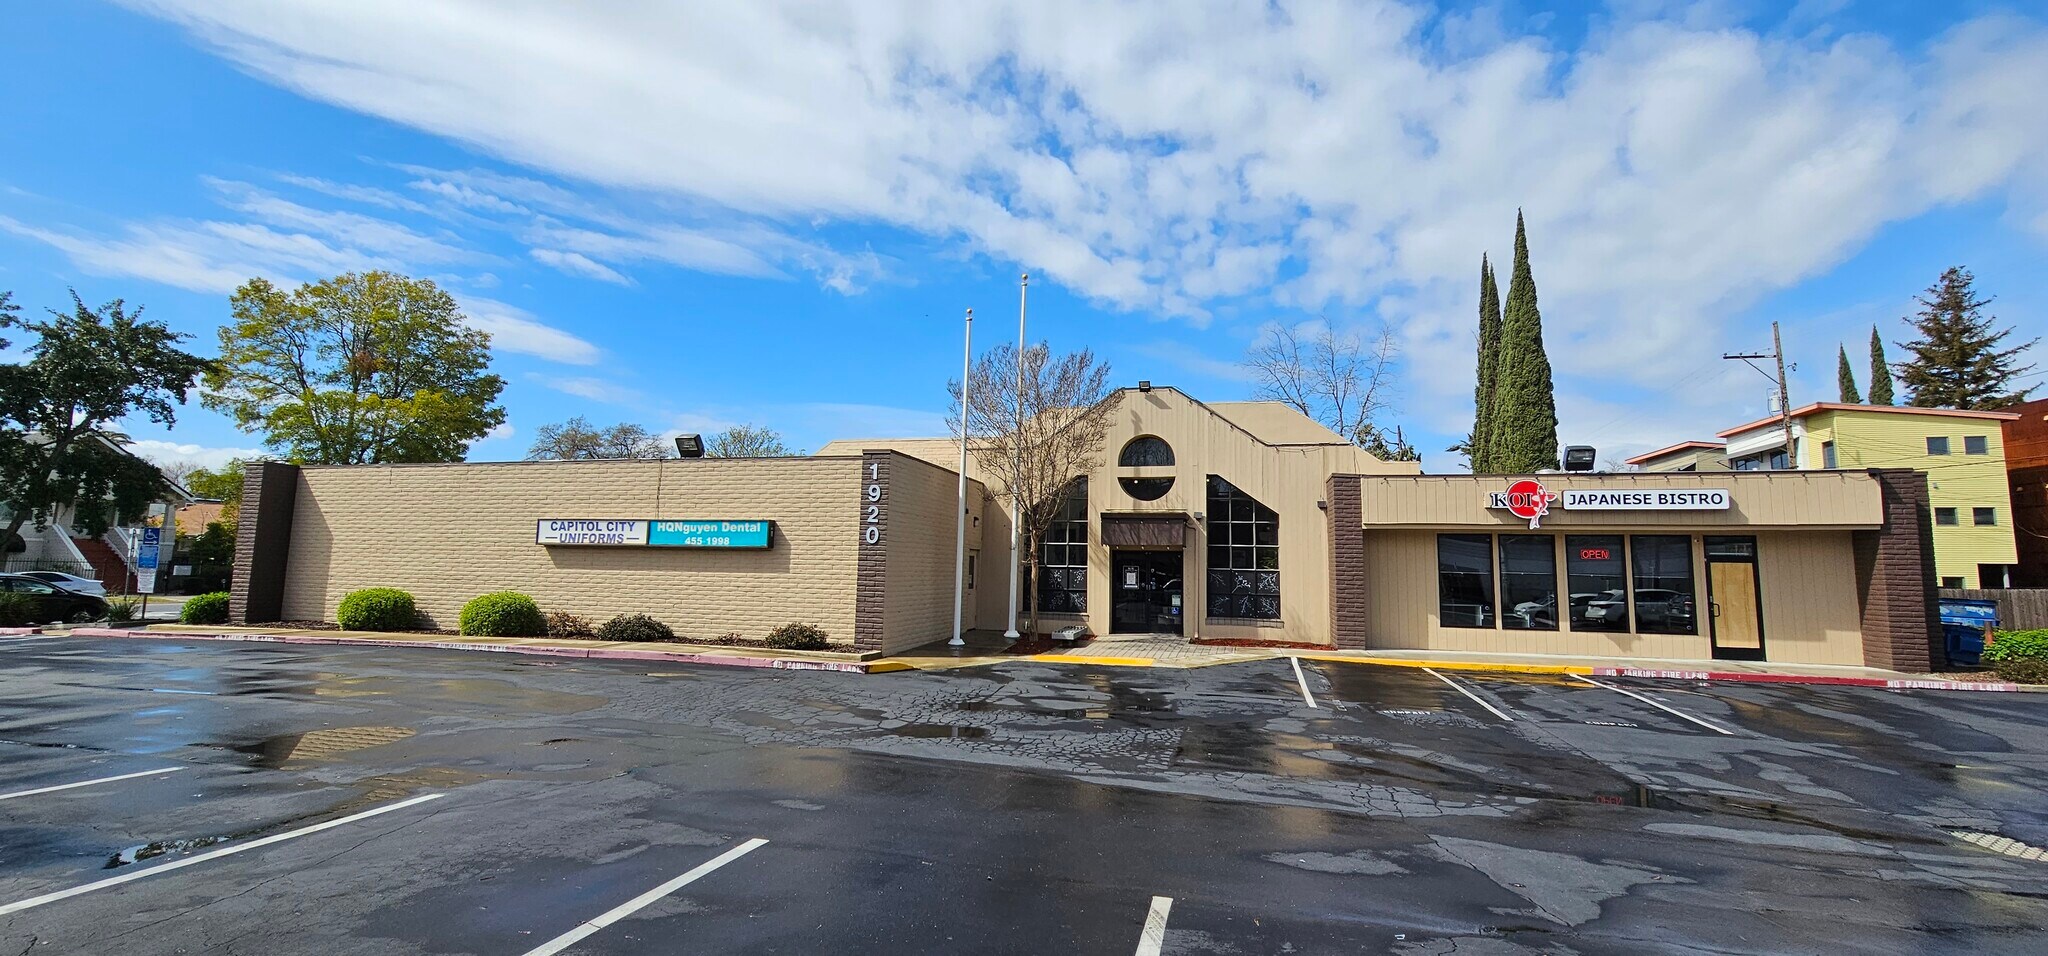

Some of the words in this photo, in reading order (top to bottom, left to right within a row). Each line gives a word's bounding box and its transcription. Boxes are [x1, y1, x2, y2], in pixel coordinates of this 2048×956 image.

[865, 463, 881, 544] 1920
[1491, 492, 1534, 508] KOI
[1568, 493, 1653, 506] JAPANESE
[1658, 492, 1724, 505] BISTRO
[550, 521, 602, 532] CAPITOL
[606, 521, 636, 532] CITY
[656, 521, 718, 534] HQNguyen
[721, 521, 761, 533] Dental
[559, 532, 624, 544] UNIFORMS
[1582, 550, 1608, 559] OPEN
[1606, 669, 1617, 677] NO
[1661, 670, 1681, 679] FIRE
[1887, 680, 1901, 688] NO
[1905, 681, 1946, 689] PARKING
[1952, 682, 1973, 691] FIRE
[1979, 683, 2005, 692] LANE
